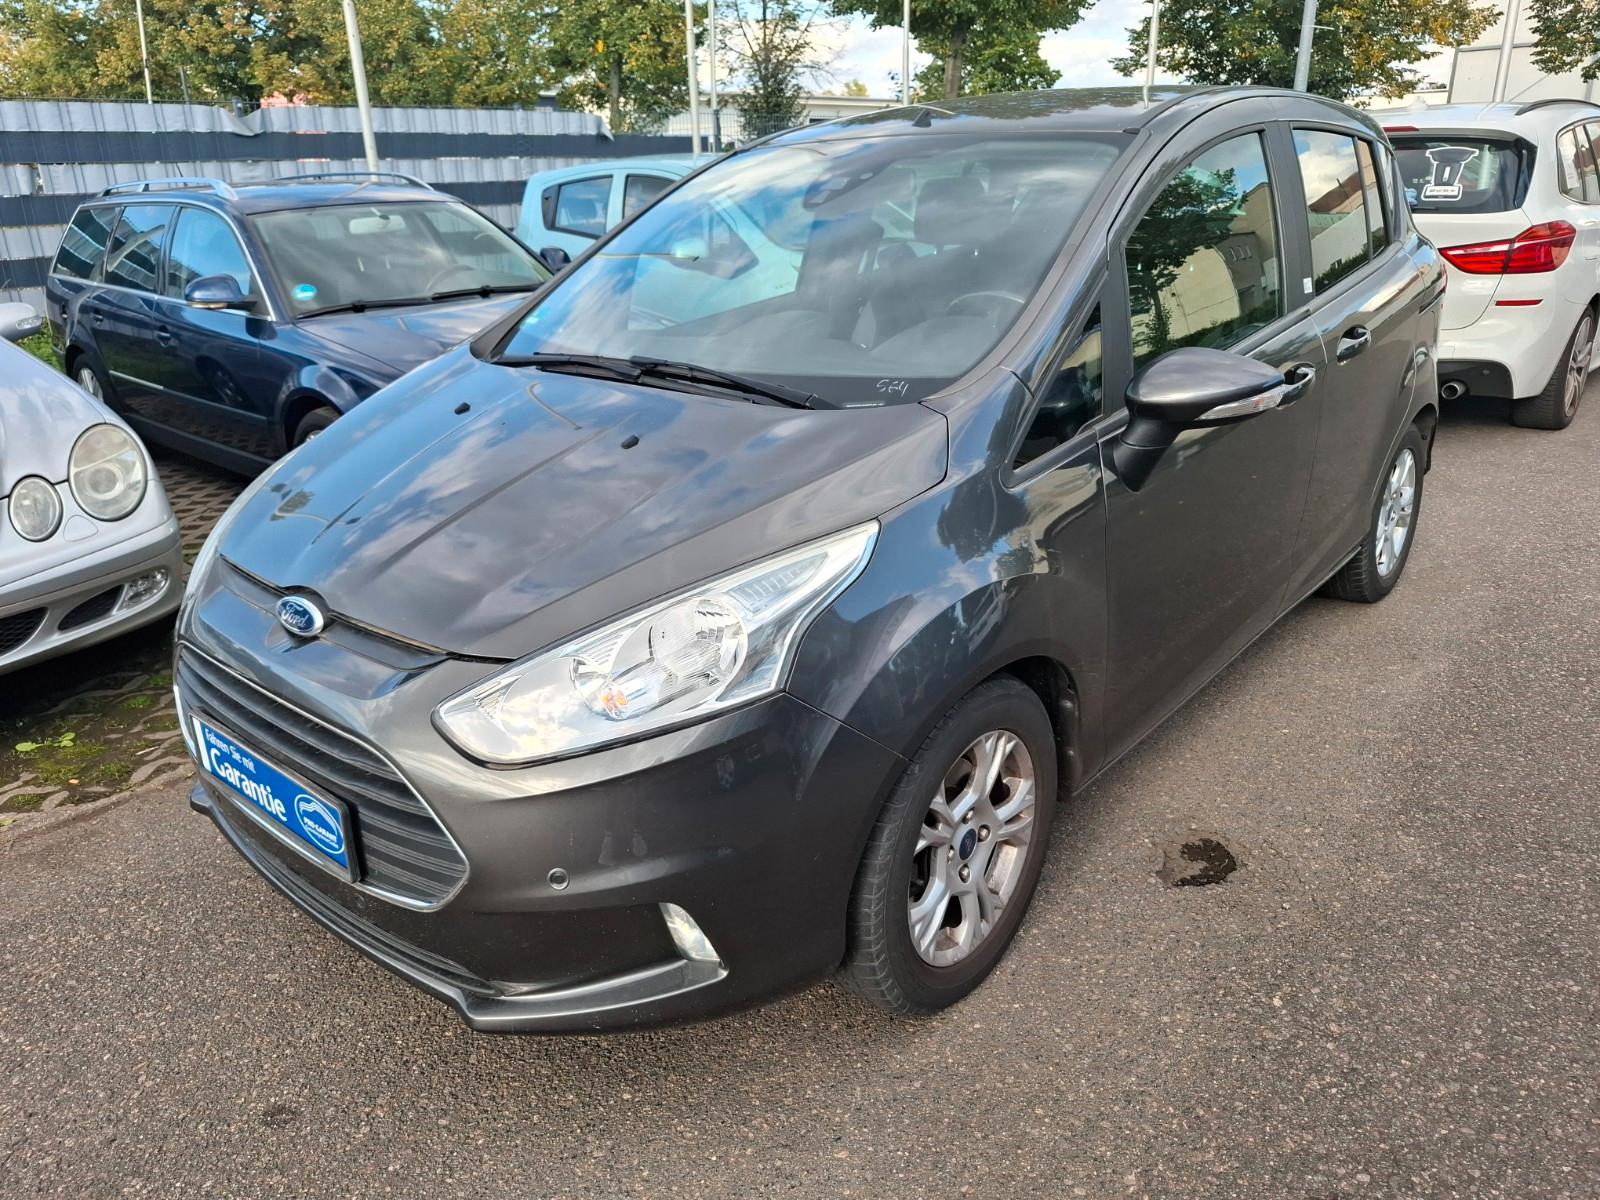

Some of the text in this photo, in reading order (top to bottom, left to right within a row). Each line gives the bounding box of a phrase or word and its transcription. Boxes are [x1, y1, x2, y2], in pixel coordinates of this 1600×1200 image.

[281, 602, 310, 628] Ford
[205, 727, 230, 755] Fahren
[230, 745, 242, 764] Sie
[210, 747, 287, 822] Garantie
